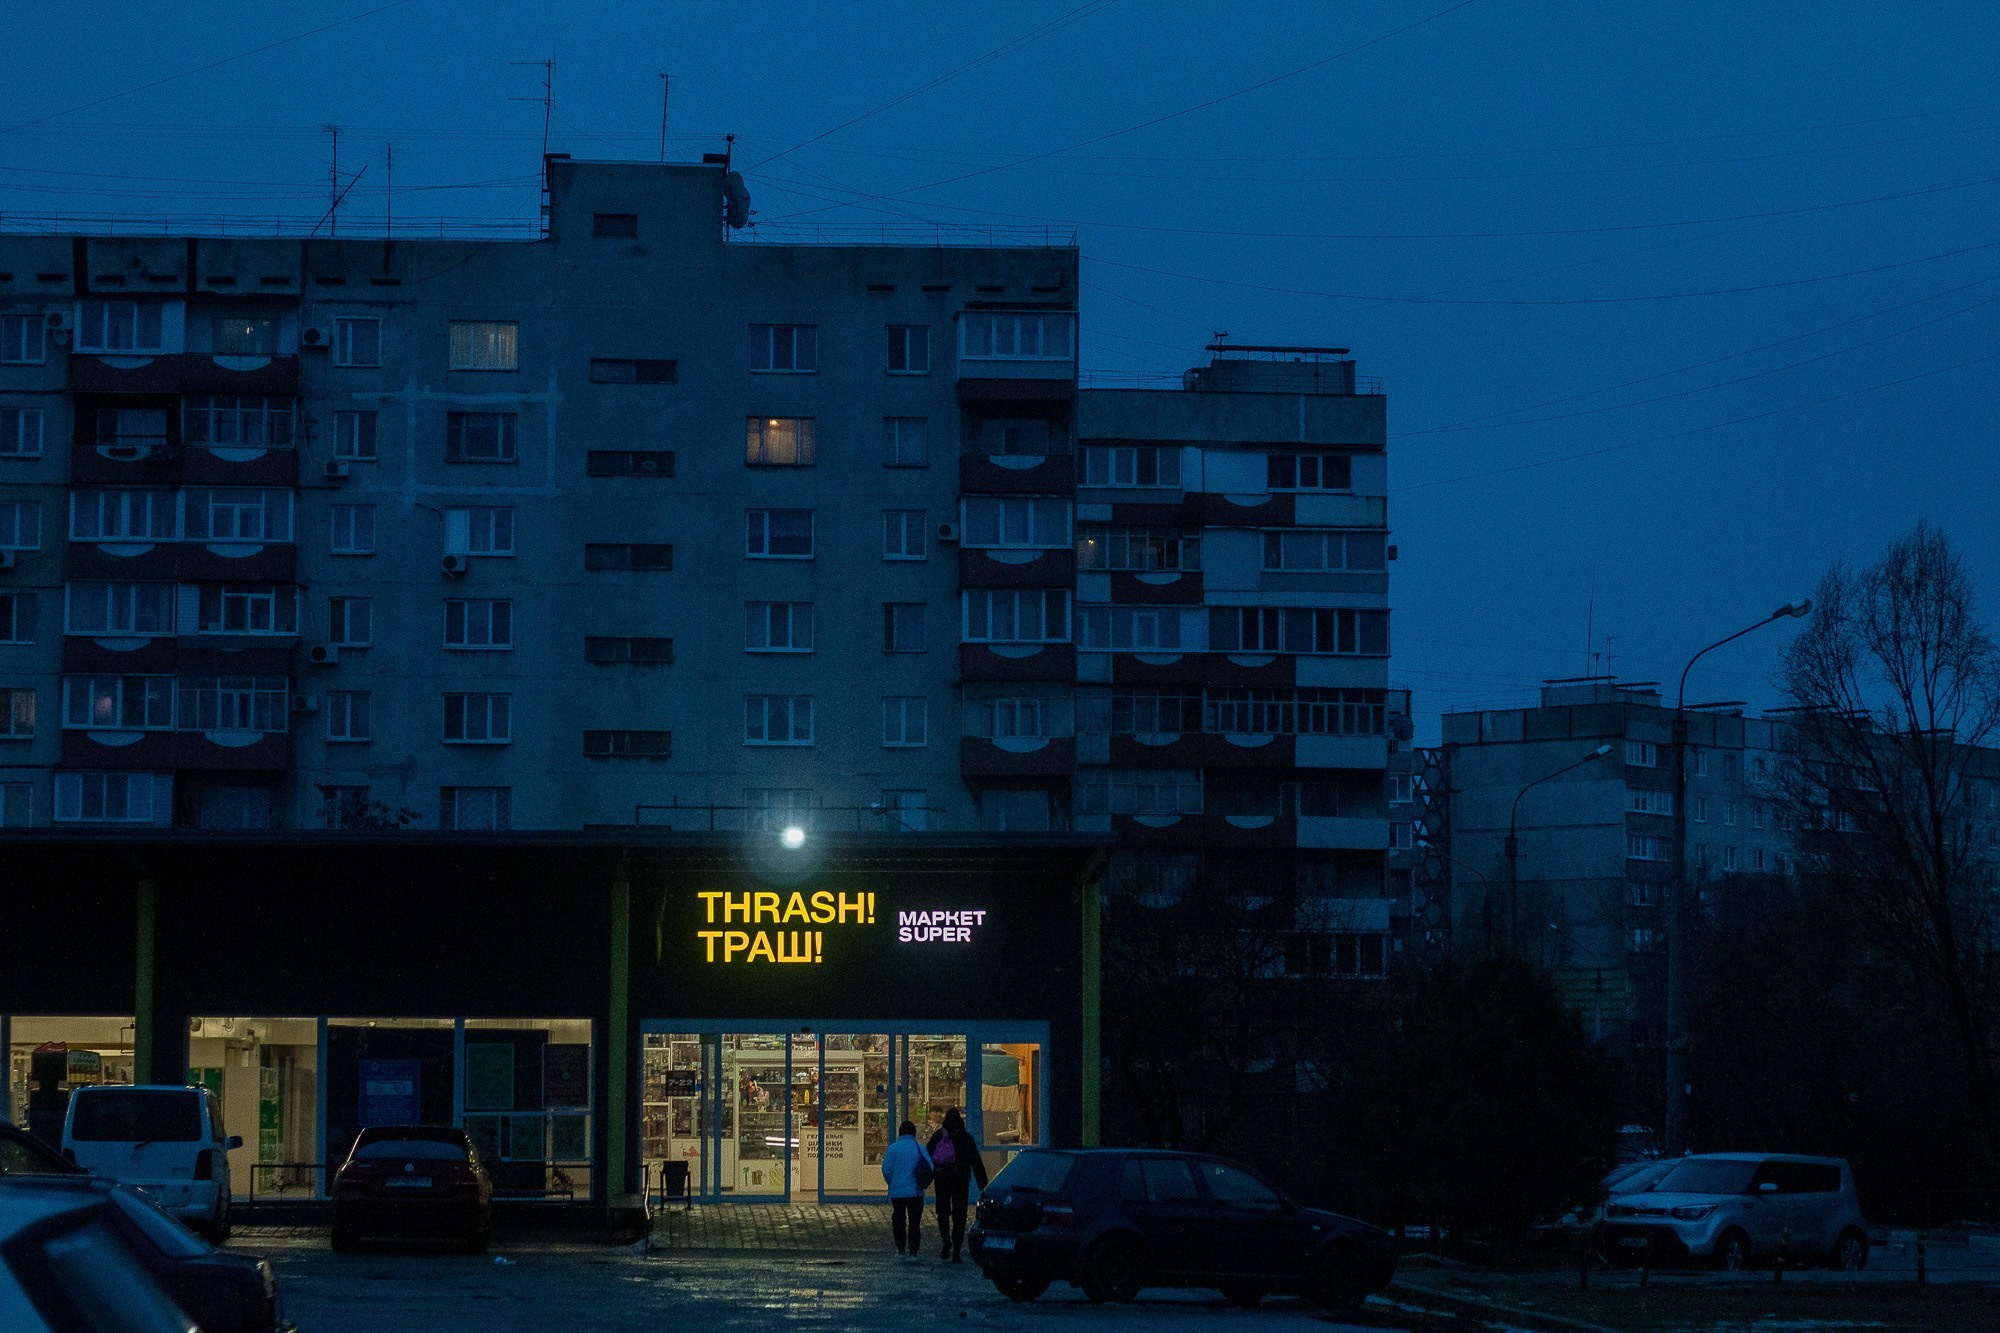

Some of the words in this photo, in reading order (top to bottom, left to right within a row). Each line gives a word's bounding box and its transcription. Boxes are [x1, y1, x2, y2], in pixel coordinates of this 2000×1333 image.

[698, 891, 875, 924] THRASH!
[899, 910, 986, 926] МАРКЕТ
[898, 926, 971, 942] SUPER
[698, 931, 822, 963] ТРАШ!
[668, 1079, 693, 1087] 7-22
